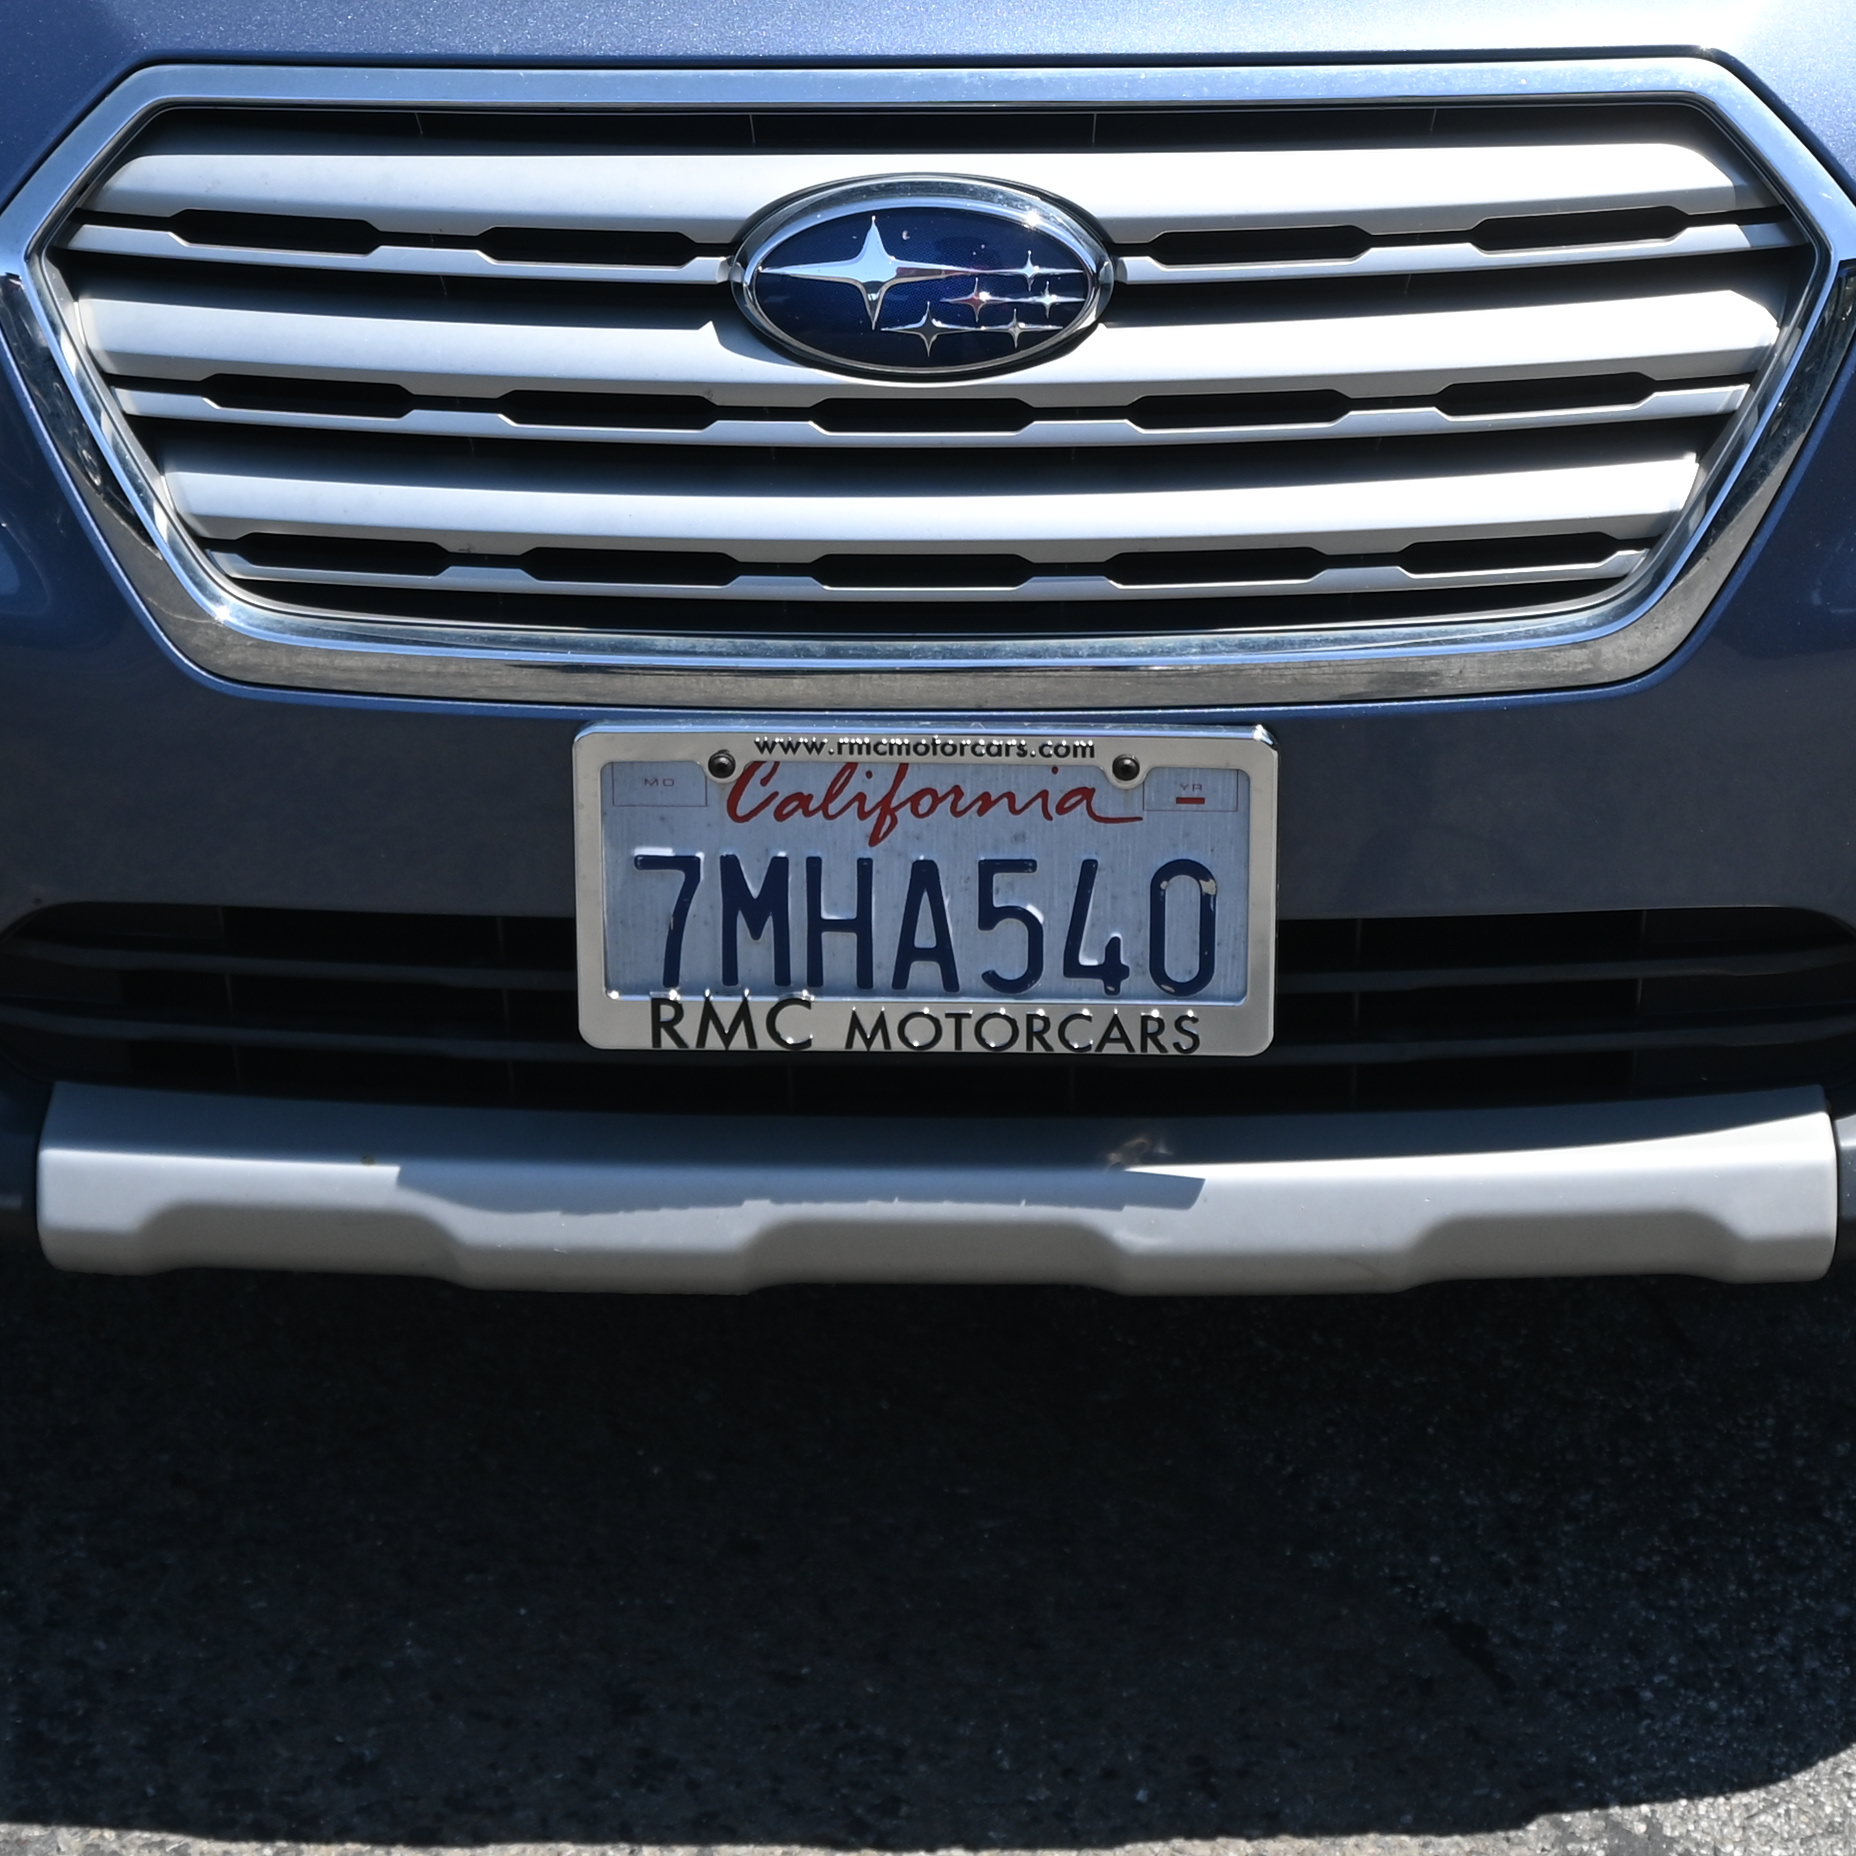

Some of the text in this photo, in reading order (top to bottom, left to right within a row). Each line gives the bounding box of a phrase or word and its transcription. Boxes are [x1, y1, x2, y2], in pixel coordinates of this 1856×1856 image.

[754, 736, 1095, 759] www.rmcmotorcars.com
[644, 777, 676, 787] MO
[1179, 783, 1203, 793] YR
[726, 761, 1143, 847] California
[633, 849, 1218, 996] 7MHA540
[649, 993, 1201, 1055] RMC MOTORCARS
